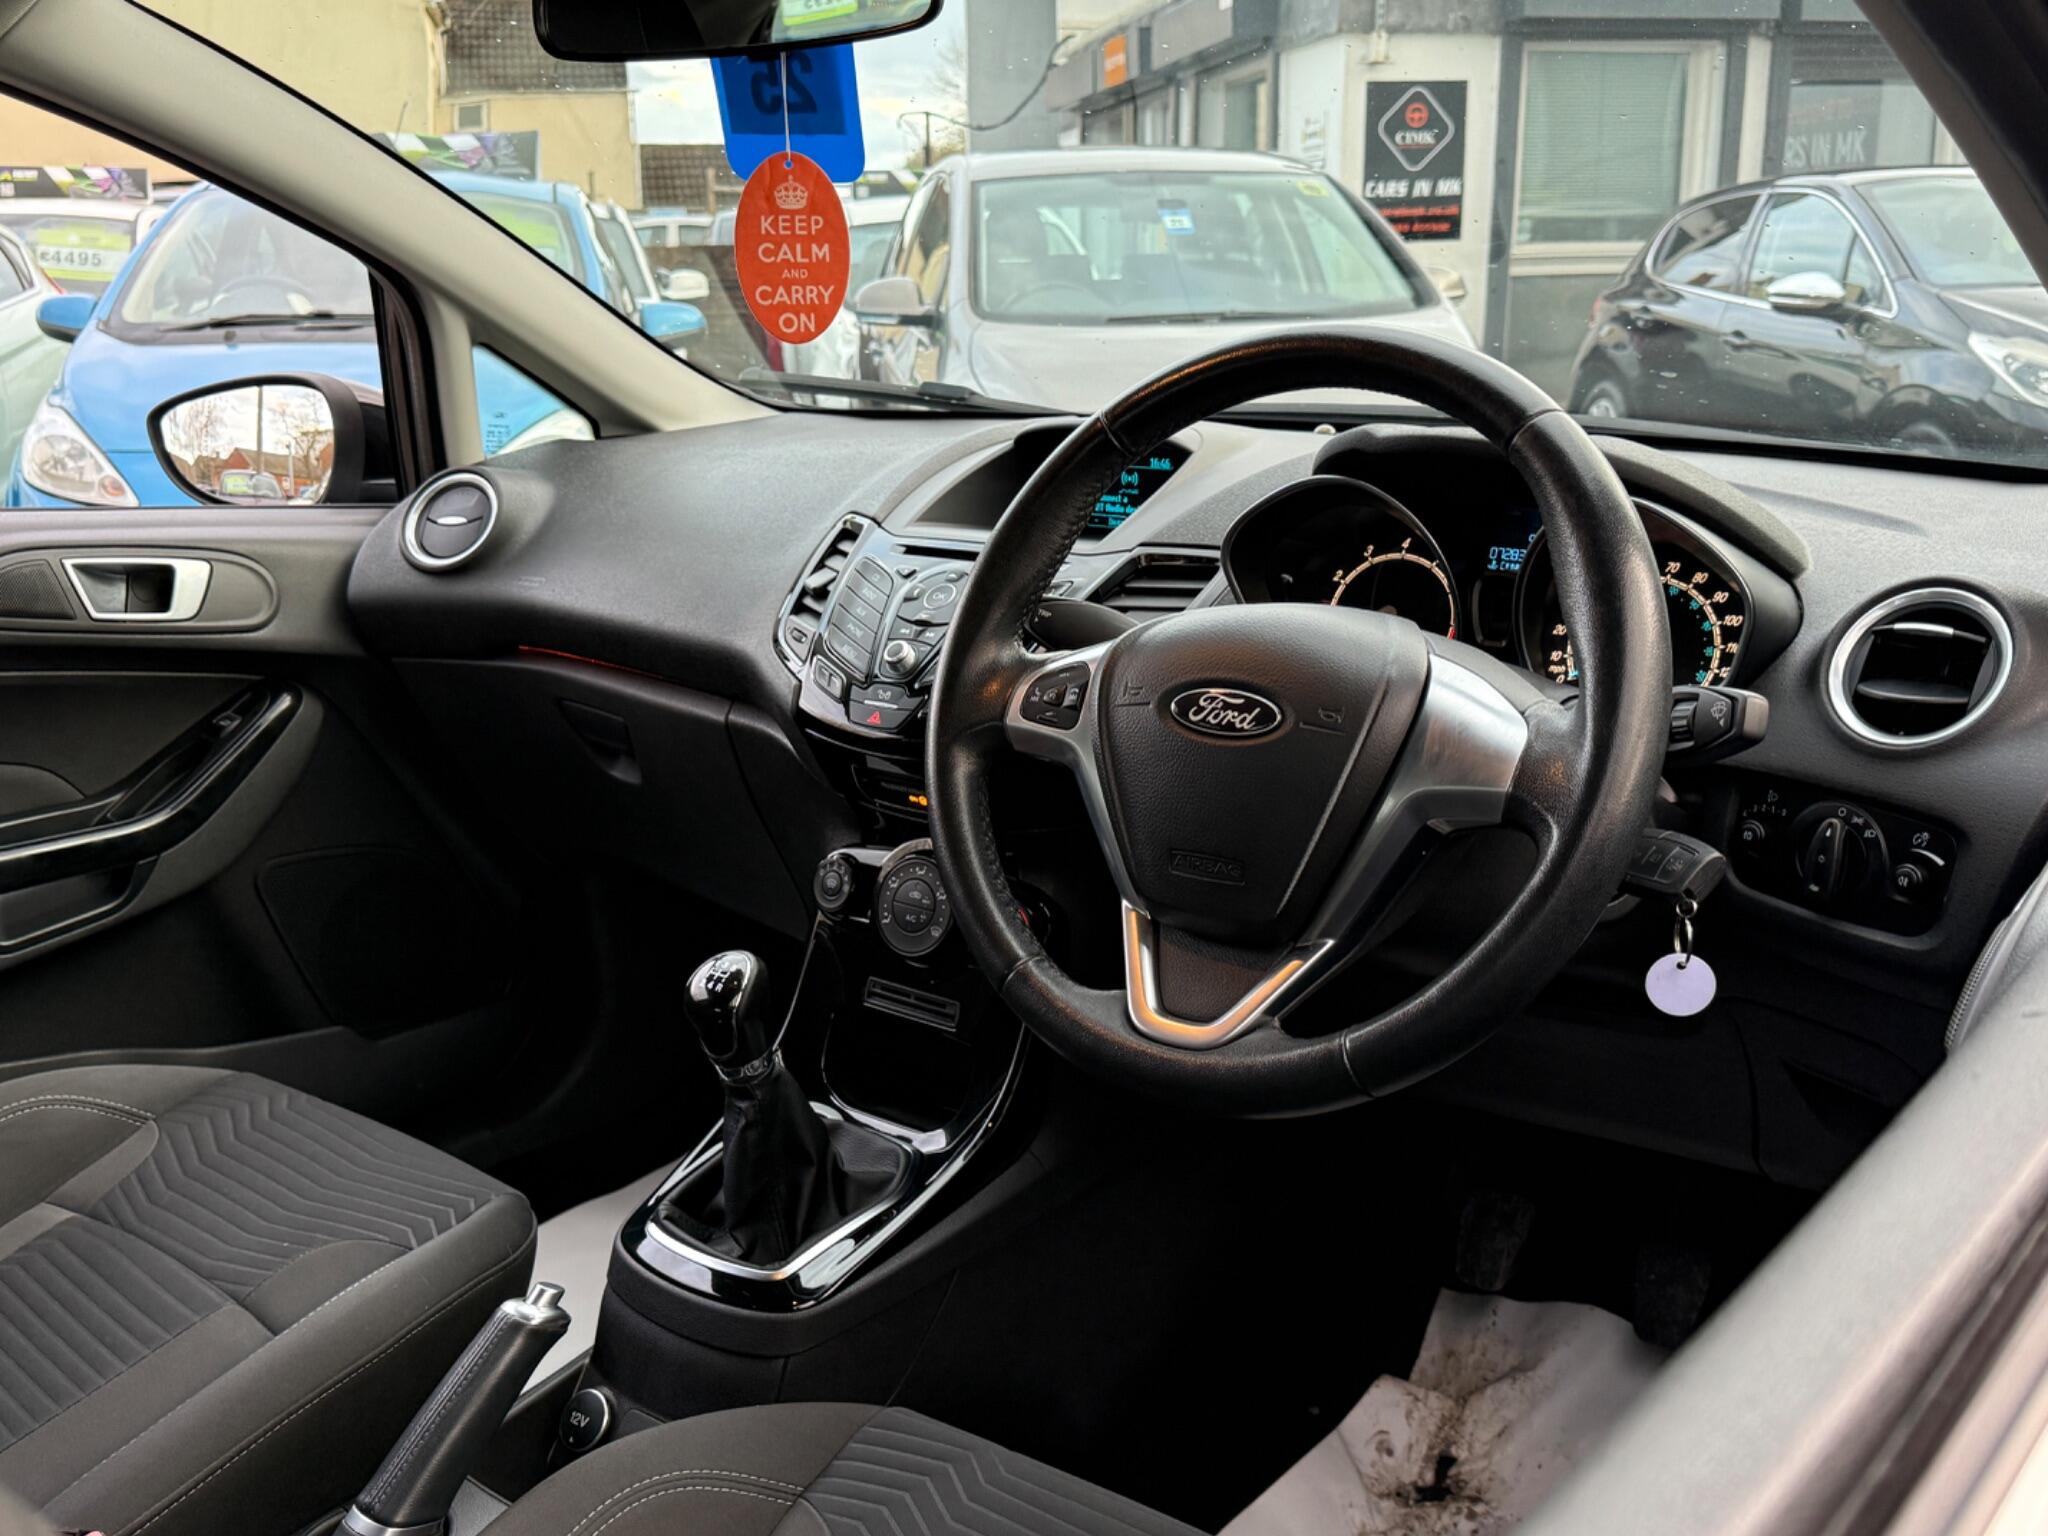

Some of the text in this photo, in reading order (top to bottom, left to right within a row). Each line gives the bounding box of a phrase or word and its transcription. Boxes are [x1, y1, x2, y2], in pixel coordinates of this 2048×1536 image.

[1364, 176, 1463, 199] CARS IN MK
[760, 214, 824, 235] KEEP
[758, 242, 830, 263] CALM
[782, 269, 809, 279] AND
[755, 285, 835, 305] CARRY
[778, 312, 816, 333] ON
[1363, 544, 1375, 558] 3
[1401, 537, 1412, 550] 4
[1332, 569, 1344, 582] 2
[1664, 561, 1681, 574] 70
[1692, 572, 1709, 584] 80
[1712, 591, 1730, 603] 90
[1724, 614, 1744, 627] 100
[1188, 692, 1261, 730] Ford
[1174, 854, 1241, 879] AIRBAG
[569, 1410, 591, 1429] 12V
